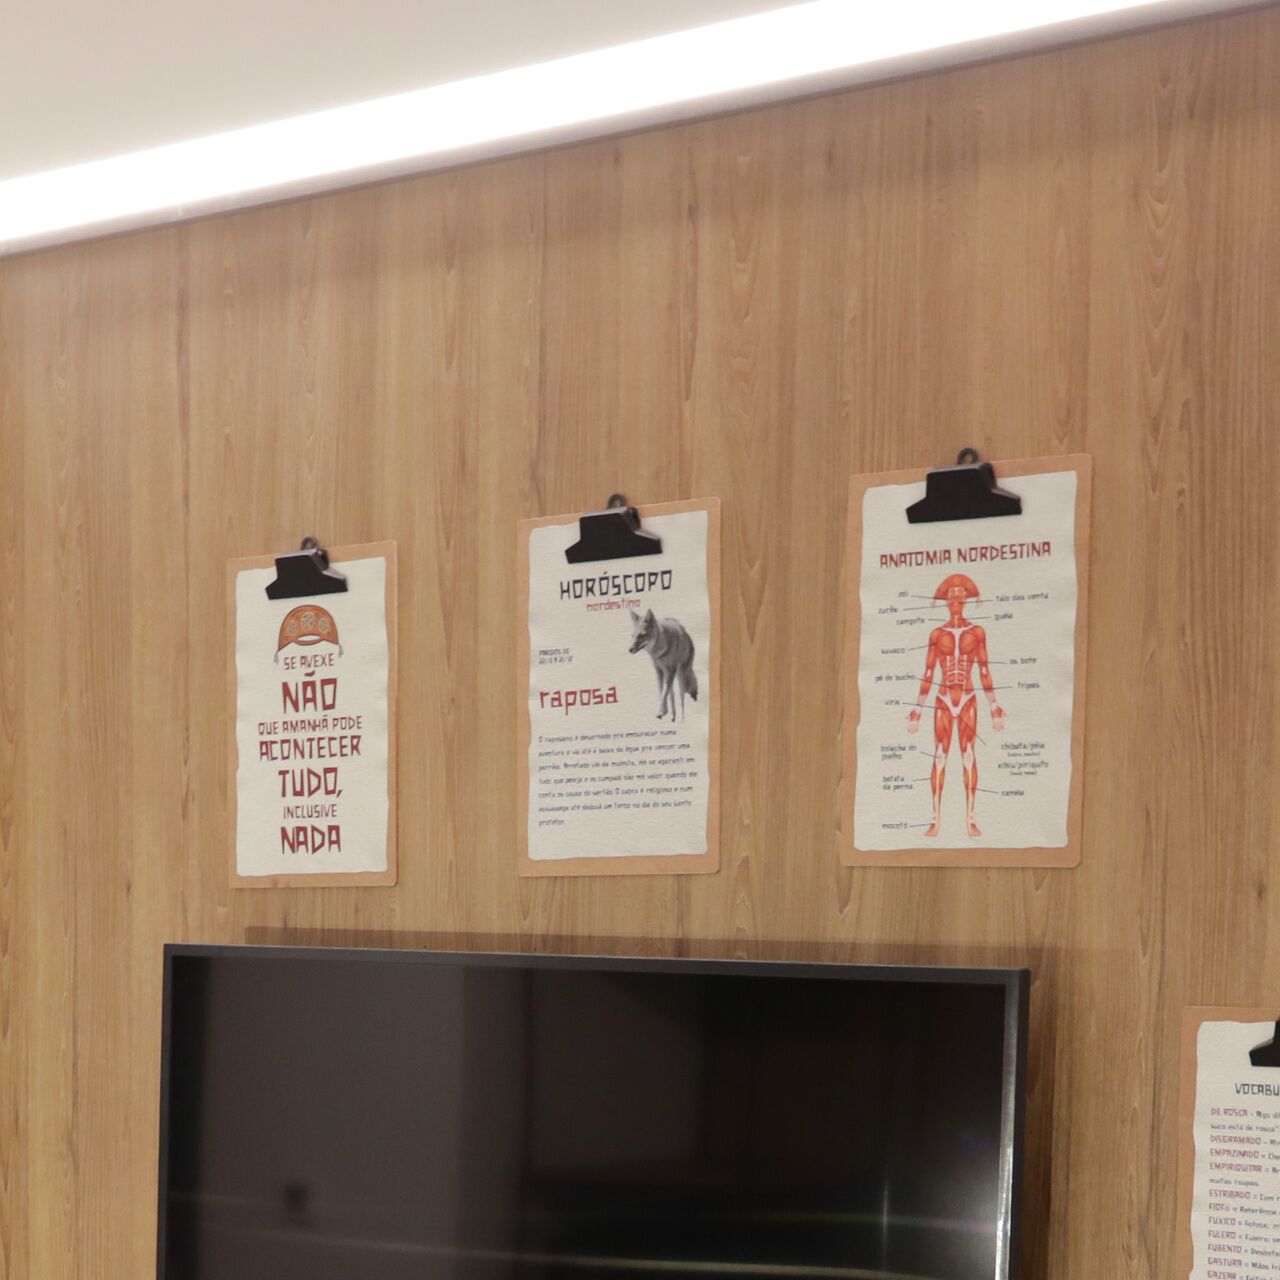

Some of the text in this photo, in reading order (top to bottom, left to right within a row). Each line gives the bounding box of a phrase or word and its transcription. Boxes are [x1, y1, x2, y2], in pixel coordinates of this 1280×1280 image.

[880, 541, 1052, 569] ANATOMIA NORDESTINA
[560, 569, 672, 600] HORÓSCOPO
[586, 597, 641, 612] nordestino
[283, 653, 334, 670] SE AVEXE
[282, 669, 337, 715] NÃO
[539, 686, 618, 716] raposa
[258, 721, 279, 735] QUE
[332, 716, 362, 731] PODE
[259, 735, 362, 761] ACONTECER
[278, 767, 342, 798] TUDO,
[283, 803, 337, 819] INCLUSIVE
[280, 824, 341, 855] NADA
